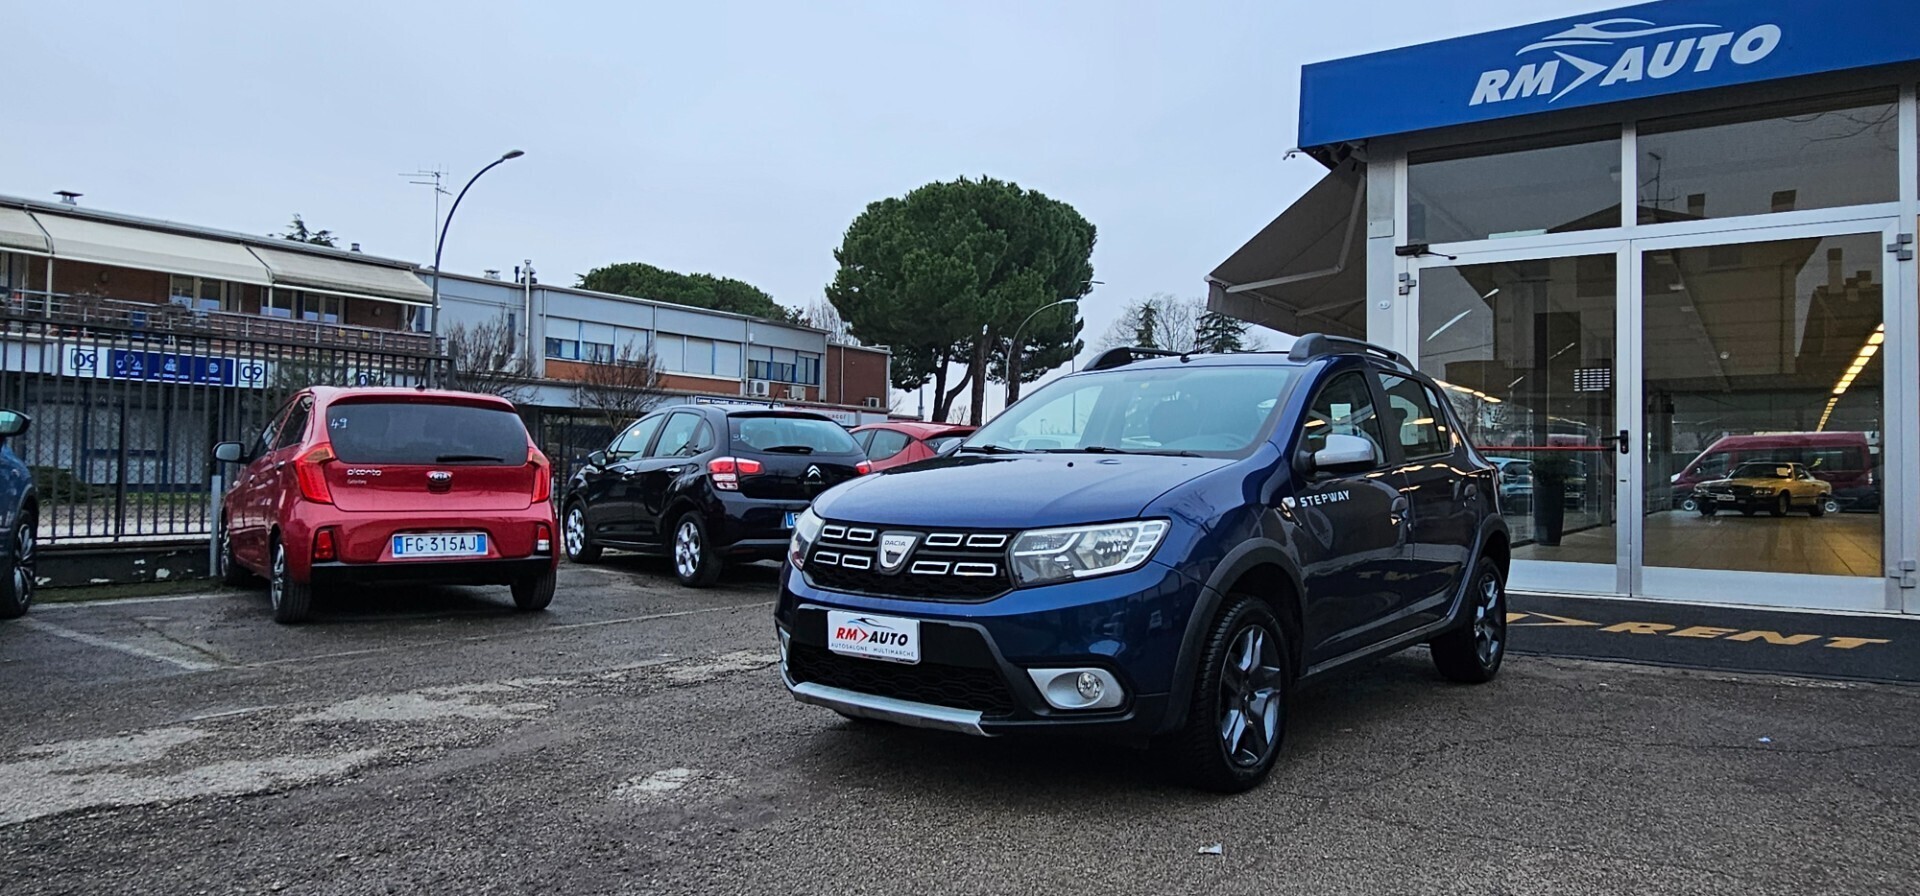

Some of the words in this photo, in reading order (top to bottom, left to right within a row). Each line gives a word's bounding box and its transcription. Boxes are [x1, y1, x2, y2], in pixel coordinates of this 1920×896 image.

[1469, 60, 1560, 106] RM
[1599, 24, 1782, 87] AUTO
[74, 352, 97, 368] 09
[242, 364, 263, 380] 09
[331, 418, 348, 429] 49
[1300, 490, 1350, 507] STEPWAY
[836, 627, 858, 641] RM
[868, 630, 908, 647] AUTO
[1598, 621, 1893, 650] RENT
[831, 642, 868, 652] AUTOSALONE
[873, 647, 914, 657] MULTIMARCHE
